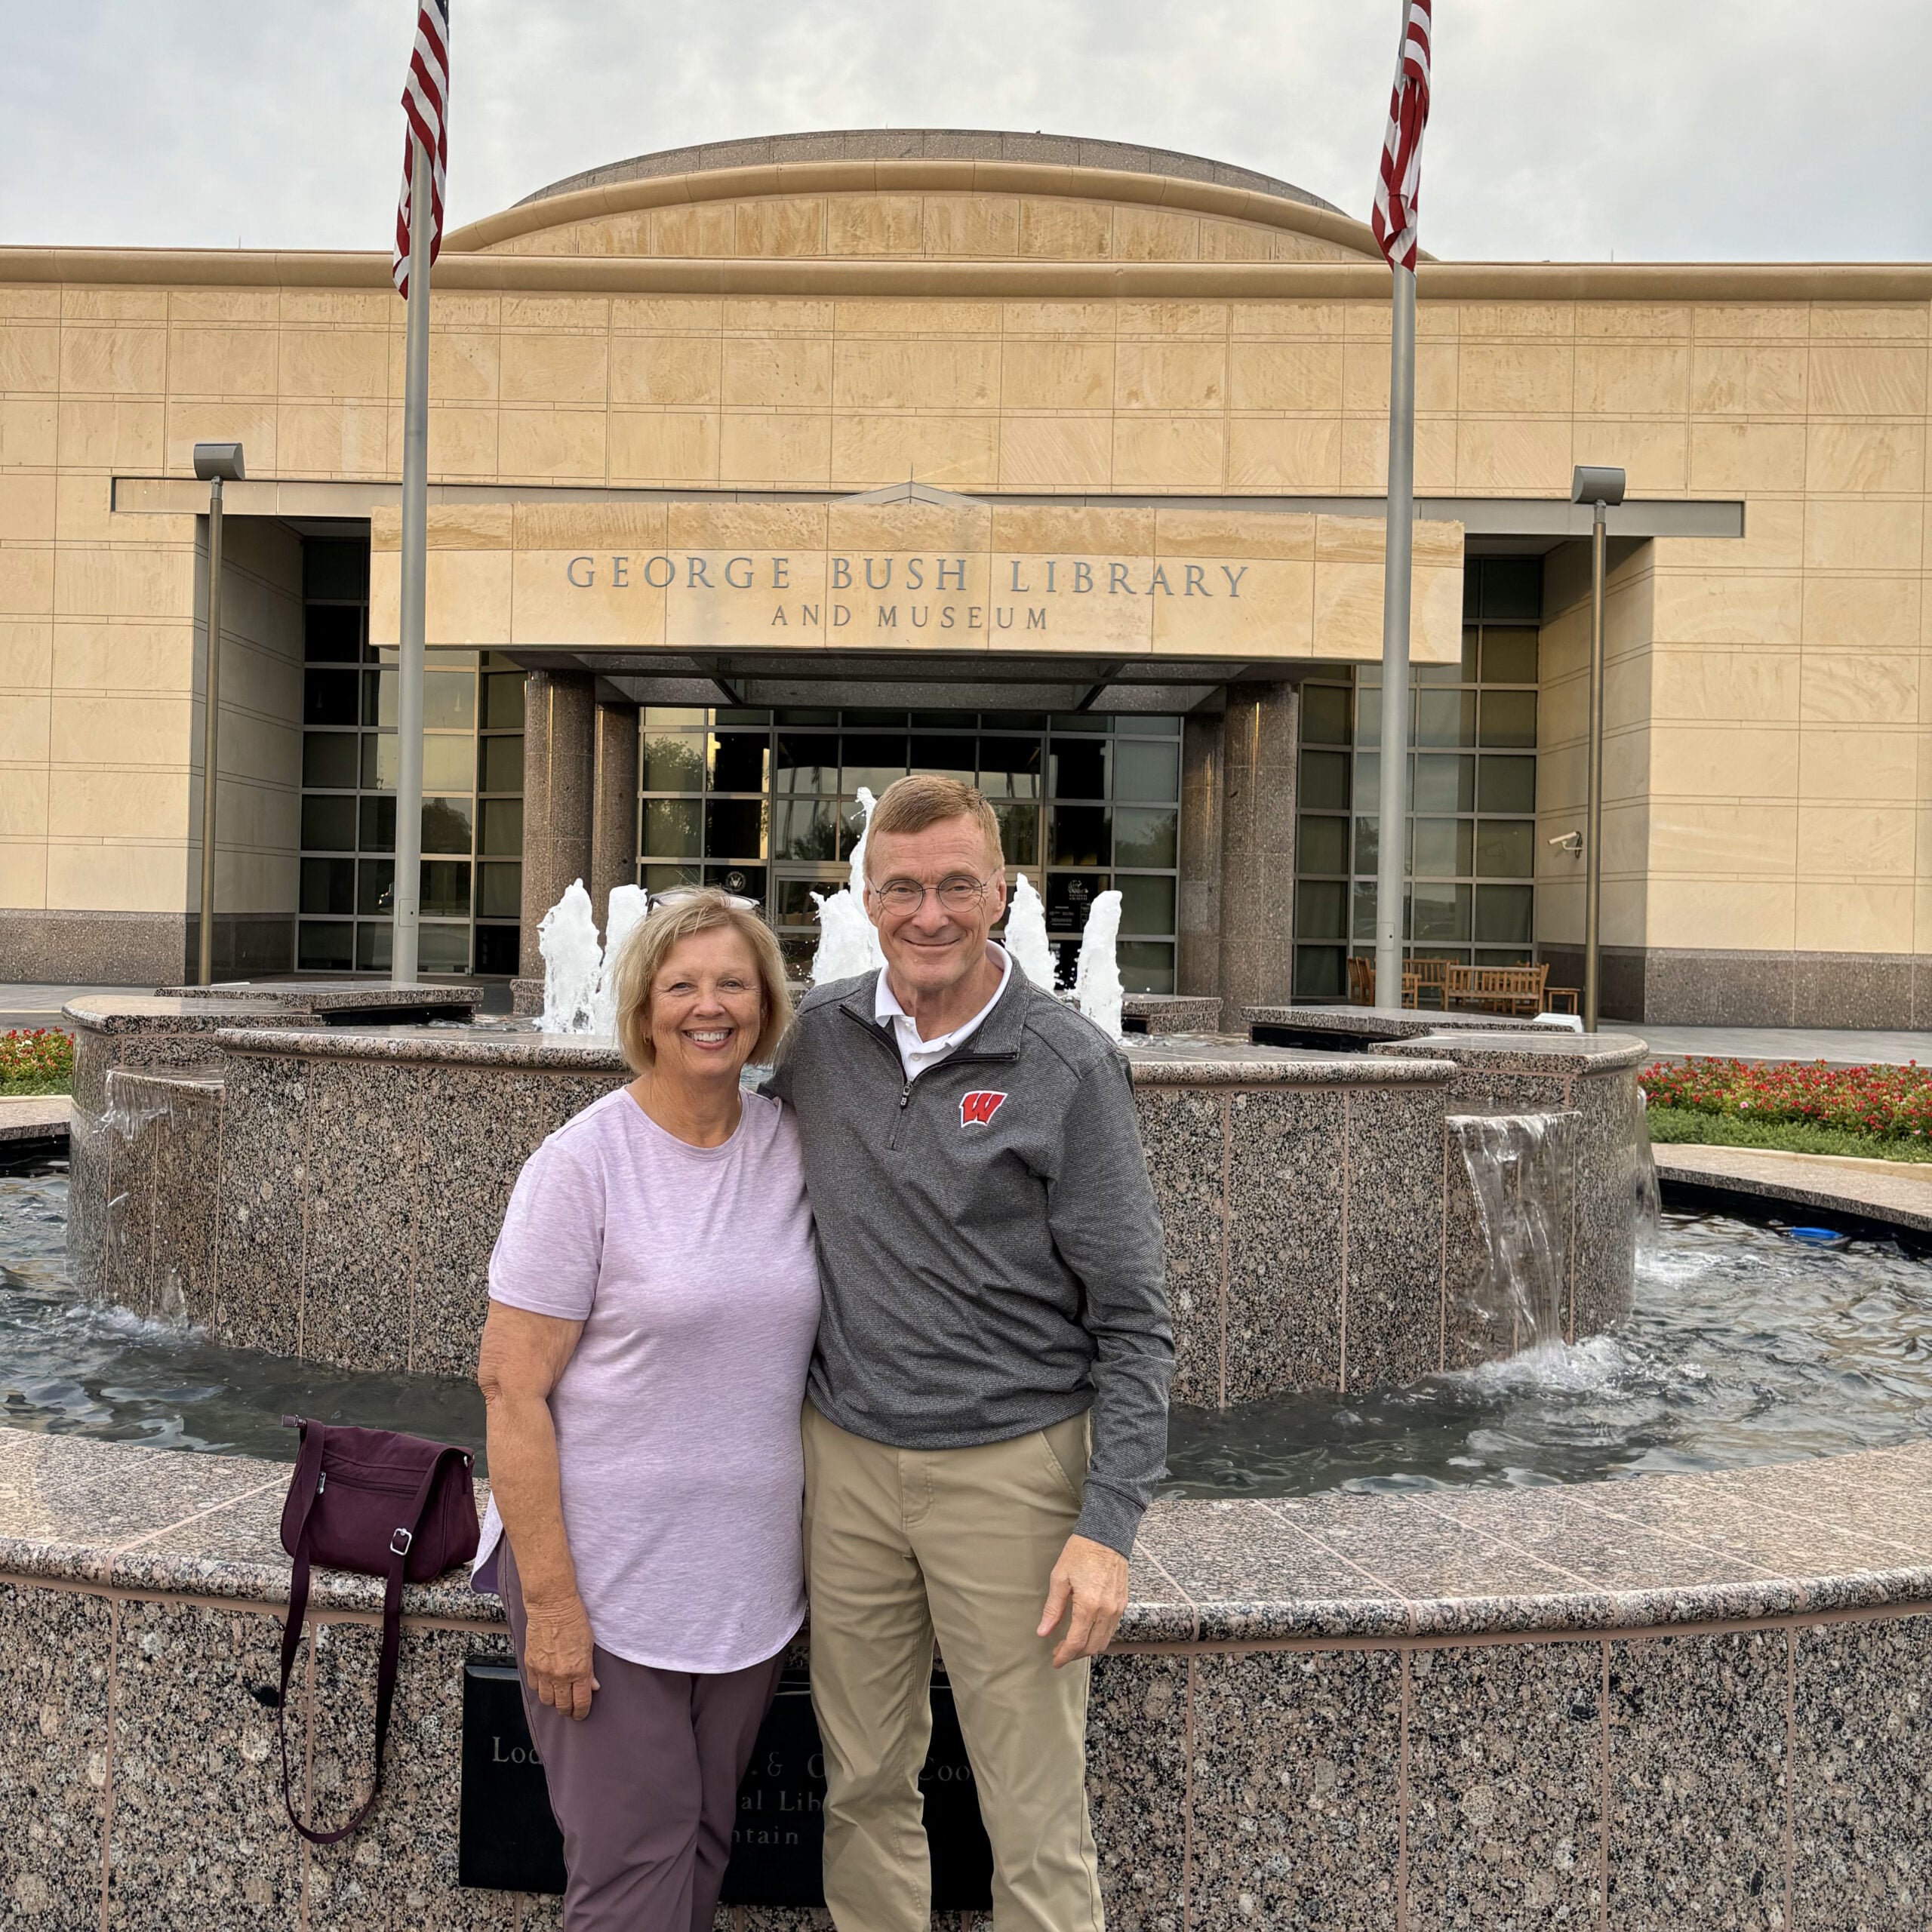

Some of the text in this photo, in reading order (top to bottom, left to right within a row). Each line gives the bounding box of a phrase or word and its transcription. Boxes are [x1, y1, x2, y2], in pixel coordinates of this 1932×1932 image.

[567, 556, 1249, 598] GEORGE BUSH LIBRARY
[771, 605, 1048, 630] AND MUSEUM
[958, 1090, 1008, 1128] W
[767, 1751, 784, 1777] &
